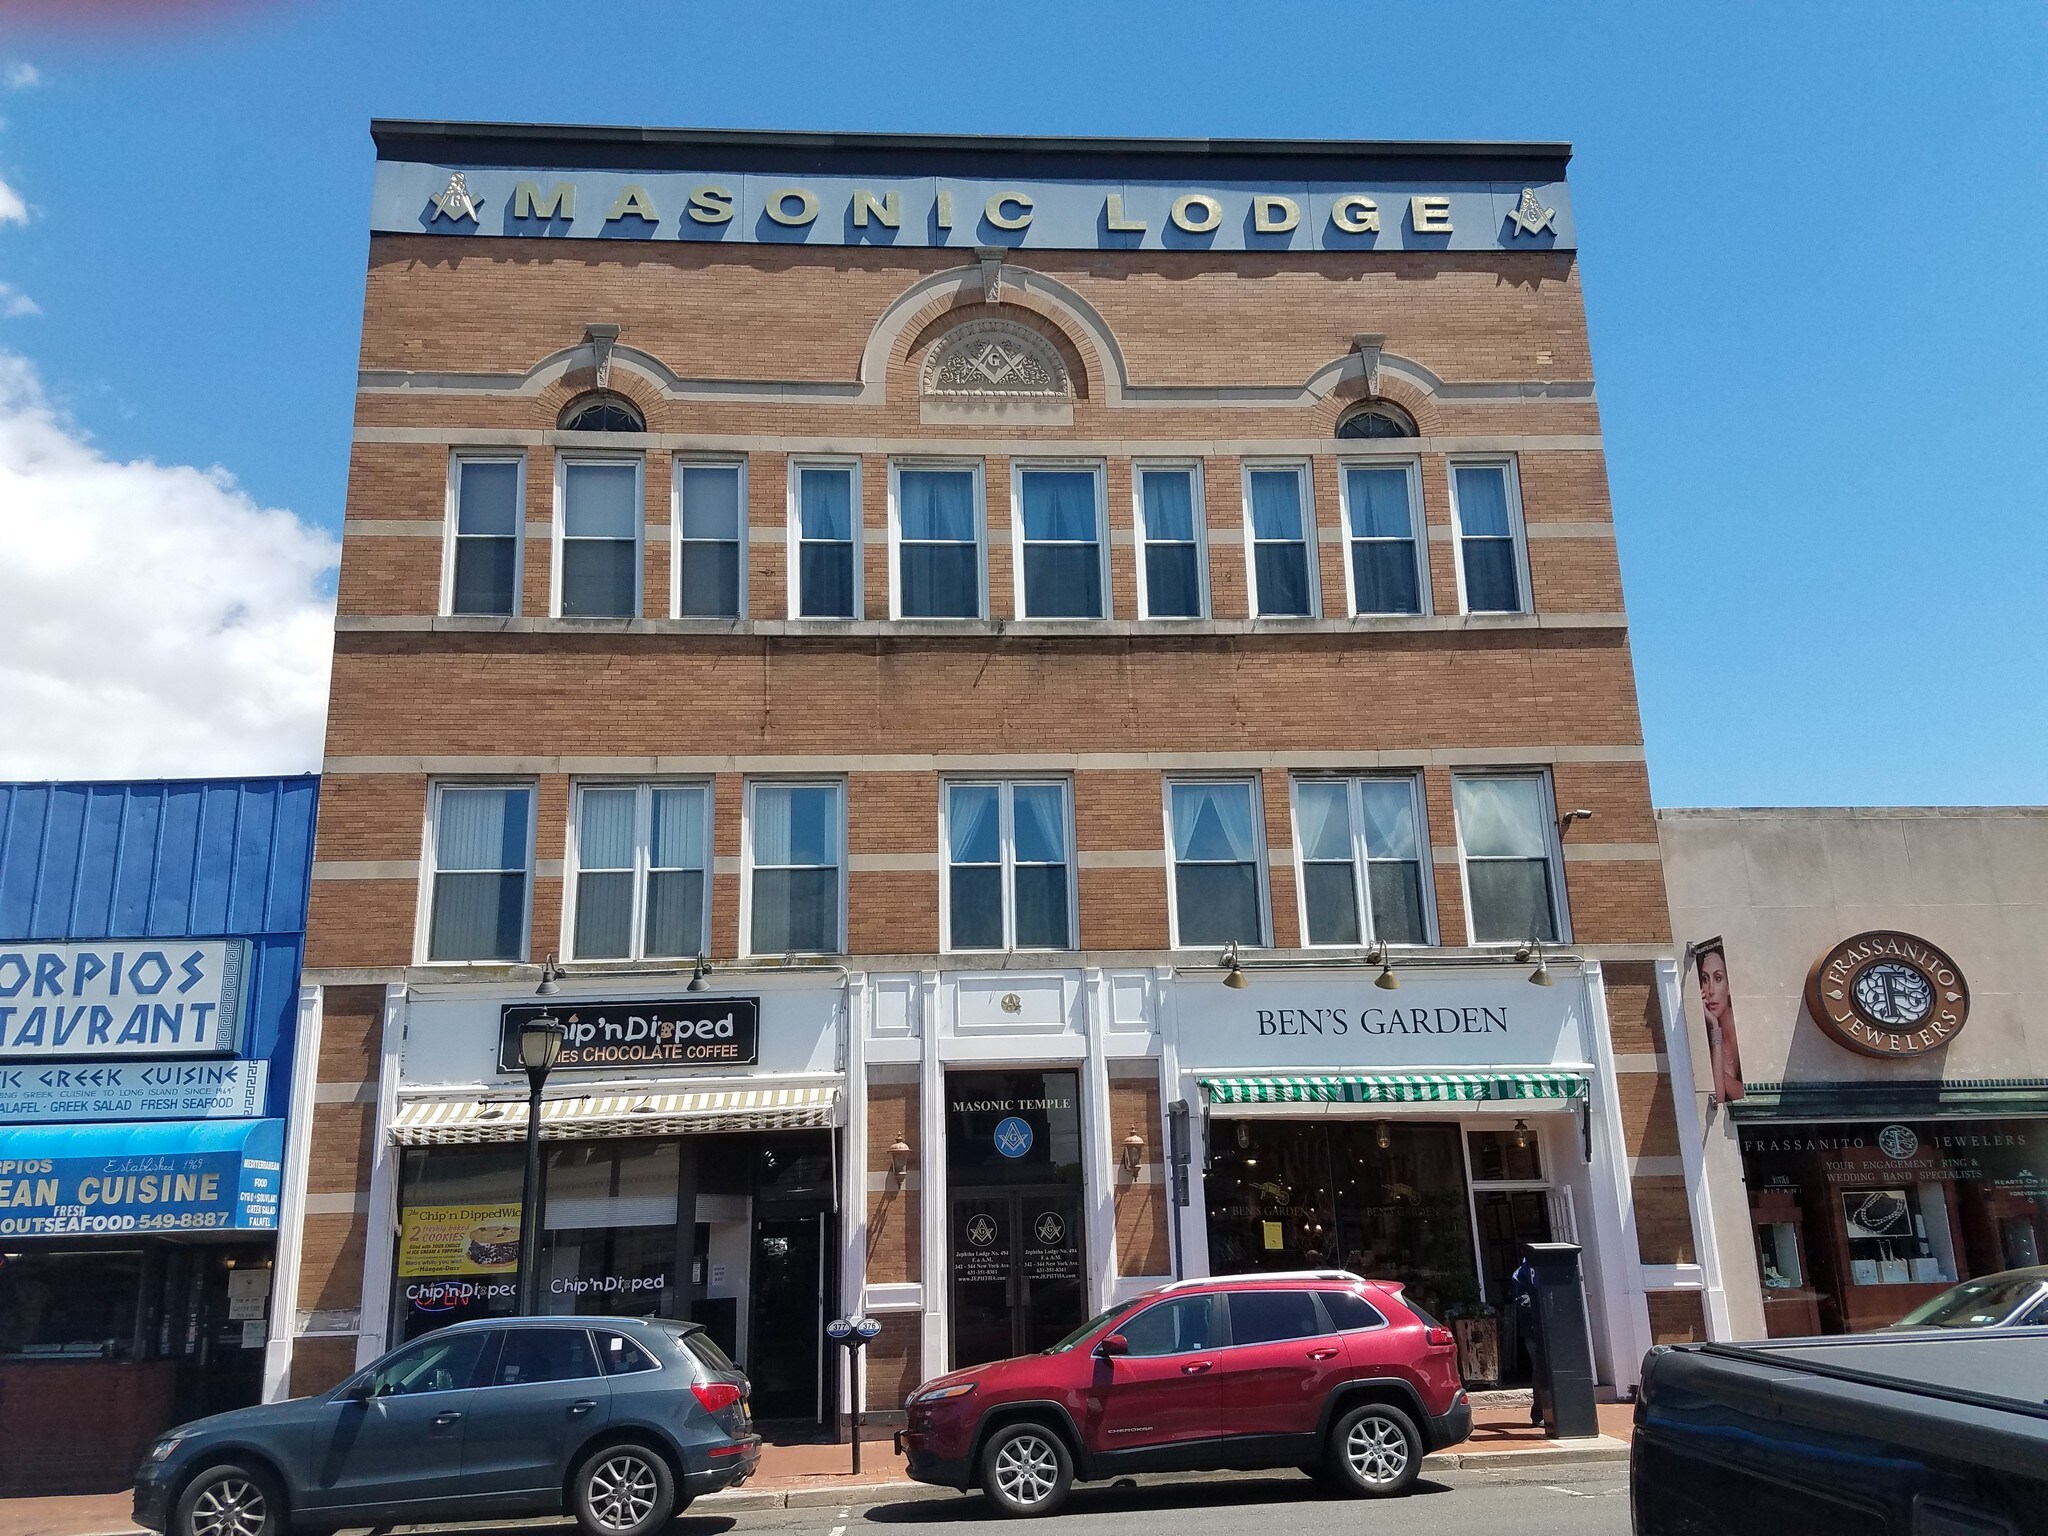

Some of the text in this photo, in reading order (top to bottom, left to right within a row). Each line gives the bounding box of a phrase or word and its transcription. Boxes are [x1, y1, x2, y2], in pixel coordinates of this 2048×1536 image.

[513, 180, 1454, 235] MASONIC LODGE
[1828, 938, 1955, 986] FRASSANITO
[1256, 1007, 1508, 1036] BEN'S GARDEN
[1834, 1009, 1957, 1051] JEWELERS
[583, 1044, 683, 1063] CHOCOLATE
[687, 1044, 739, 1059] COFFEE
[39, 1069, 122, 1088] GREEK
[140, 1066, 239, 1085] CUISINE
[60, 1090, 98, 1098] CUISINE
[103, 1089, 114, 1097] TO
[119, 1089, 144, 1097] LONG
[148, 1088, 178, 1096] ISLAND
[50, 1101, 89, 1112] GREEK
[93, 1099, 132, 1111] SALAD
[141, 1099, 179, 1110] FRESH
[182, 1097, 233, 1109] SEAFOOD
[953, 1098, 1071, 1112] MASONIC TEMPLE
[1745, 1135, 2026, 1151] FRASSANITO JEWELERS
[103, 1157, 175, 1173] Established
[183, 1159, 203, 1171] 1969
[1826, 1161, 1855, 1170] YOUR
[1863, 1160, 1934, 1169] ENGAGEMENT
[1942, 1159, 1967, 1167] RING
[254, 1178, 268, 1188] FOOD
[1827, 1170, 1982, 1182] WEDDING BAND SPECIALISTS
[78, 1172, 220, 1205] CUISINE
[53, 1205, 86, 1217] FRESH
[419, 1211, 458, 1222] Chip'n
[44, 1215, 135, 1232] SEAFOOD
[138, 1212, 229, 1229] 549-8887
[410, 1226, 421, 1242] 2
[423, 1233, 465, 1241] COOKIES
[833, 1323, 846, 1331] 377
[862, 1322, 876, 1330] 376
